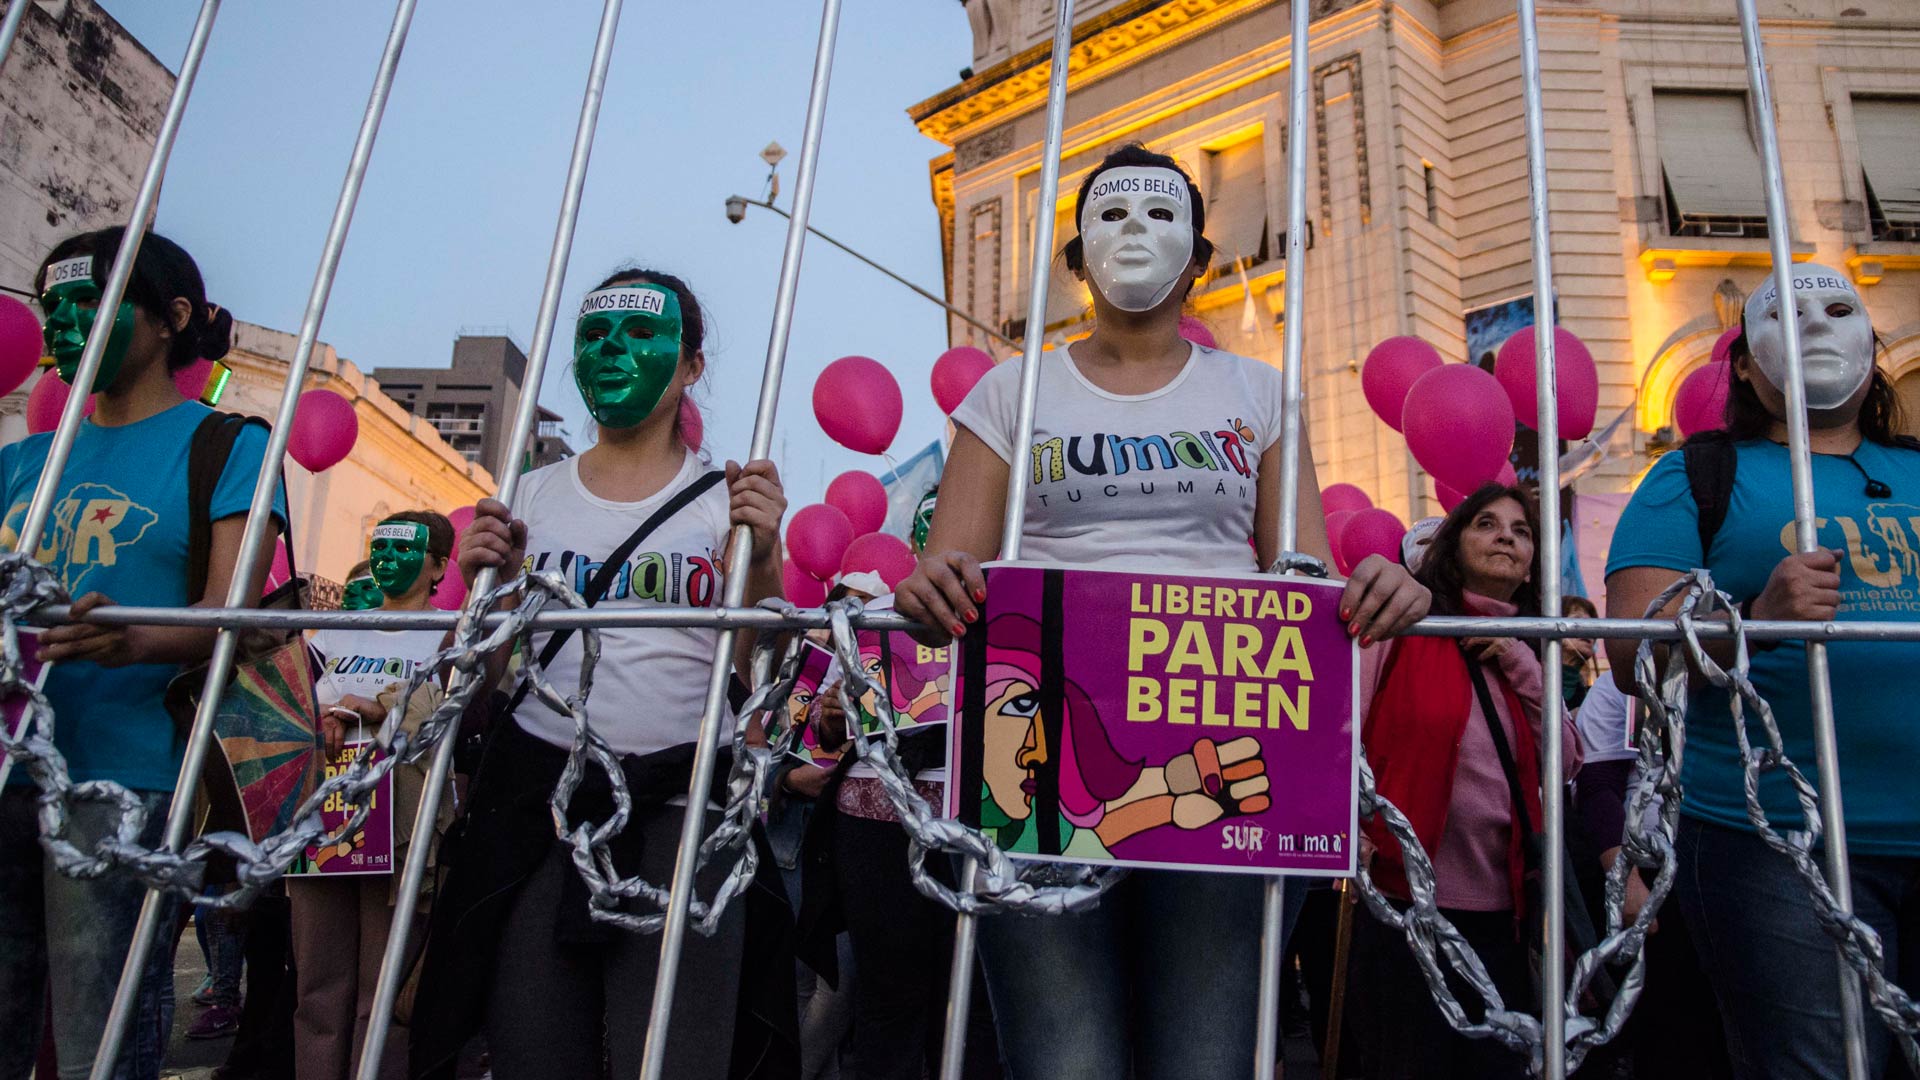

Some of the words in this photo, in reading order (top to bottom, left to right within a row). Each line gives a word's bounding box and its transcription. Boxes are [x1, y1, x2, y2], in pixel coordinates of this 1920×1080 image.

[1093, 178, 1140, 201] SOMOS
[1144, 178, 1183, 202] BELÉN
[70, 262, 92, 277] BEL
[581, 294, 616, 313] OMOS
[618, 291, 661, 313] BELÉN
[1038, 479, 1248, 507] TUCUMÁN
[1131, 582, 1312, 621] LIBERTAD
[1840, 587, 1914, 601] miento
[1128, 617, 1314, 681] PARA
[1127, 676, 1310, 731] BELEN
[1221, 824, 1263, 851] SUR
